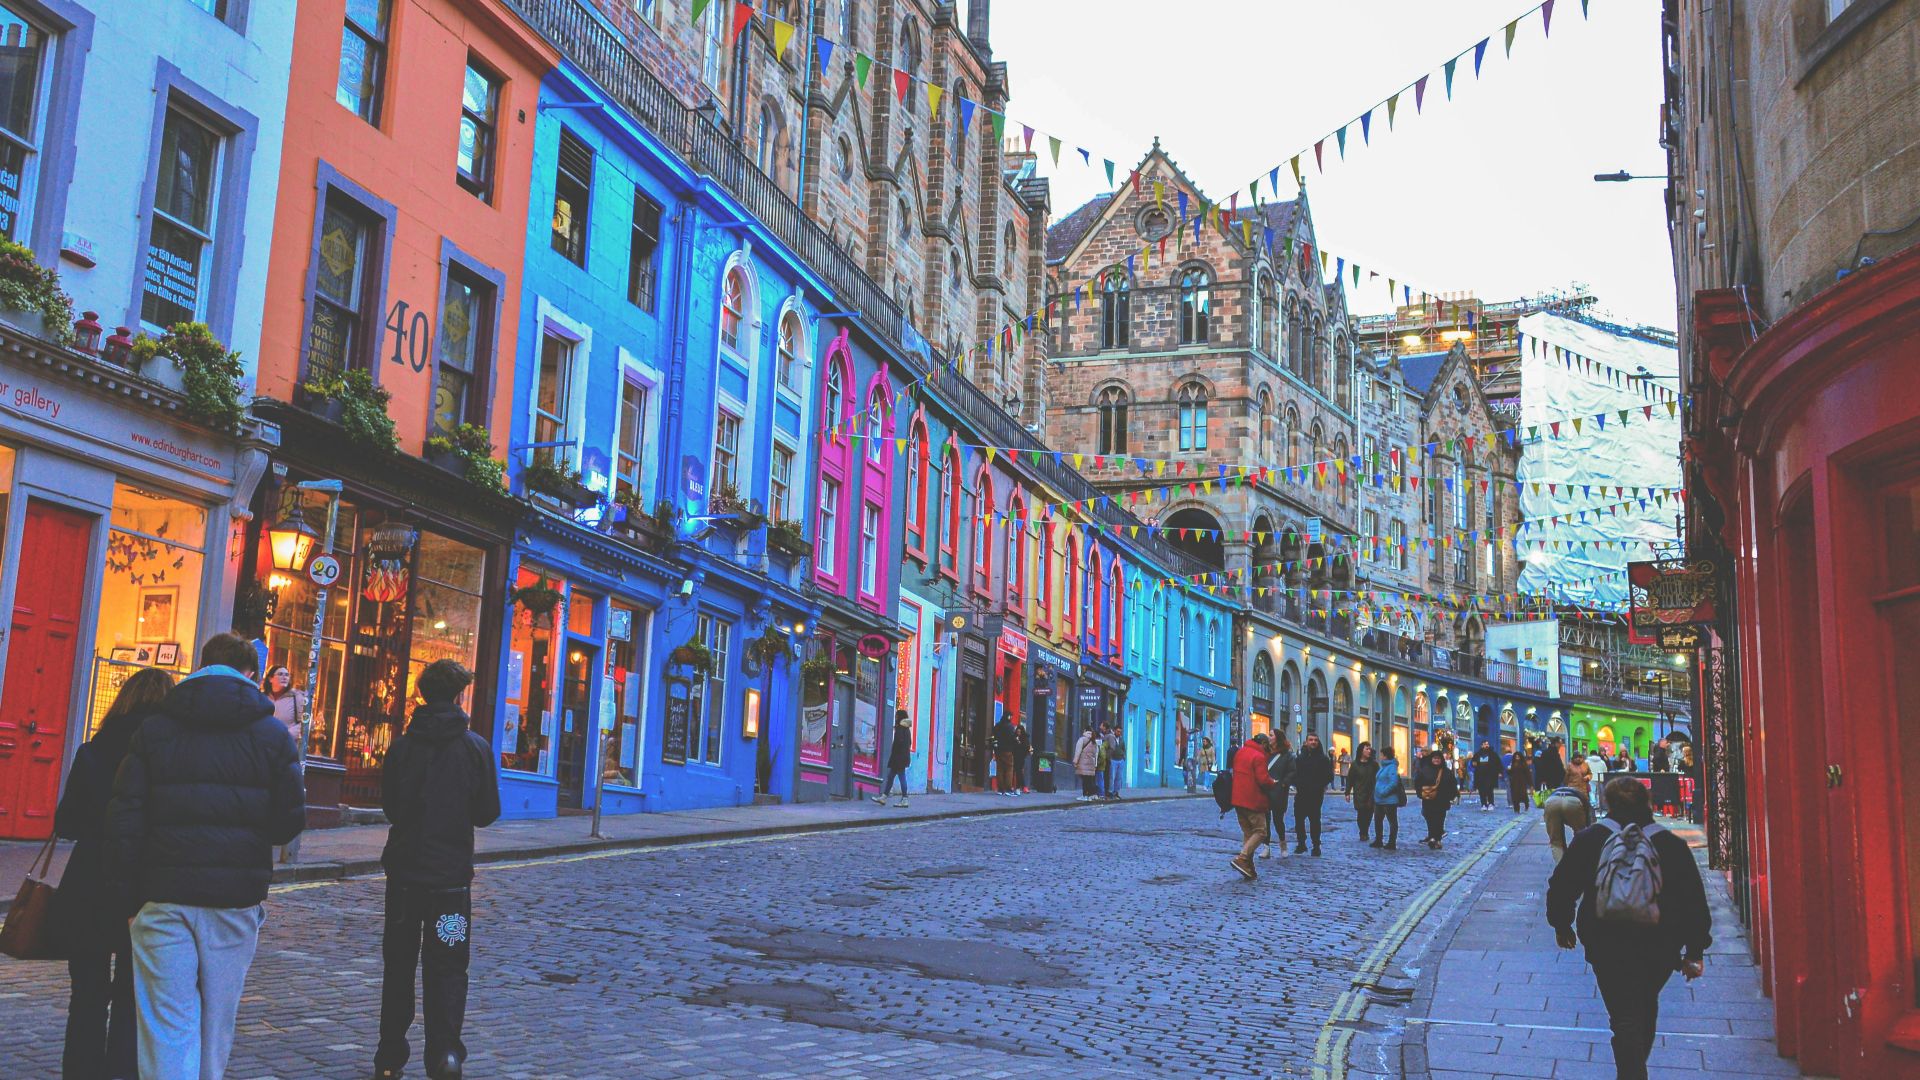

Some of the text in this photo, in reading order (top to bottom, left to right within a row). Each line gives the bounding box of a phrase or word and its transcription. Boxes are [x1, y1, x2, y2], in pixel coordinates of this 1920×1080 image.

[0, 168, 18, 191] cal
[159, 249, 169, 261] 150
[163, 276, 195, 298] Homeware
[309, 336, 340, 357] AMOUS
[386, 300, 429, 373] 40
[14, 387, 61, 418] gallery
[130, 431, 221, 470] www.edinburghart.com
[370, 543, 403, 552] ONTEXT
[312, 560, 338, 579] 20
[1037, 649, 1046, 661] THE
